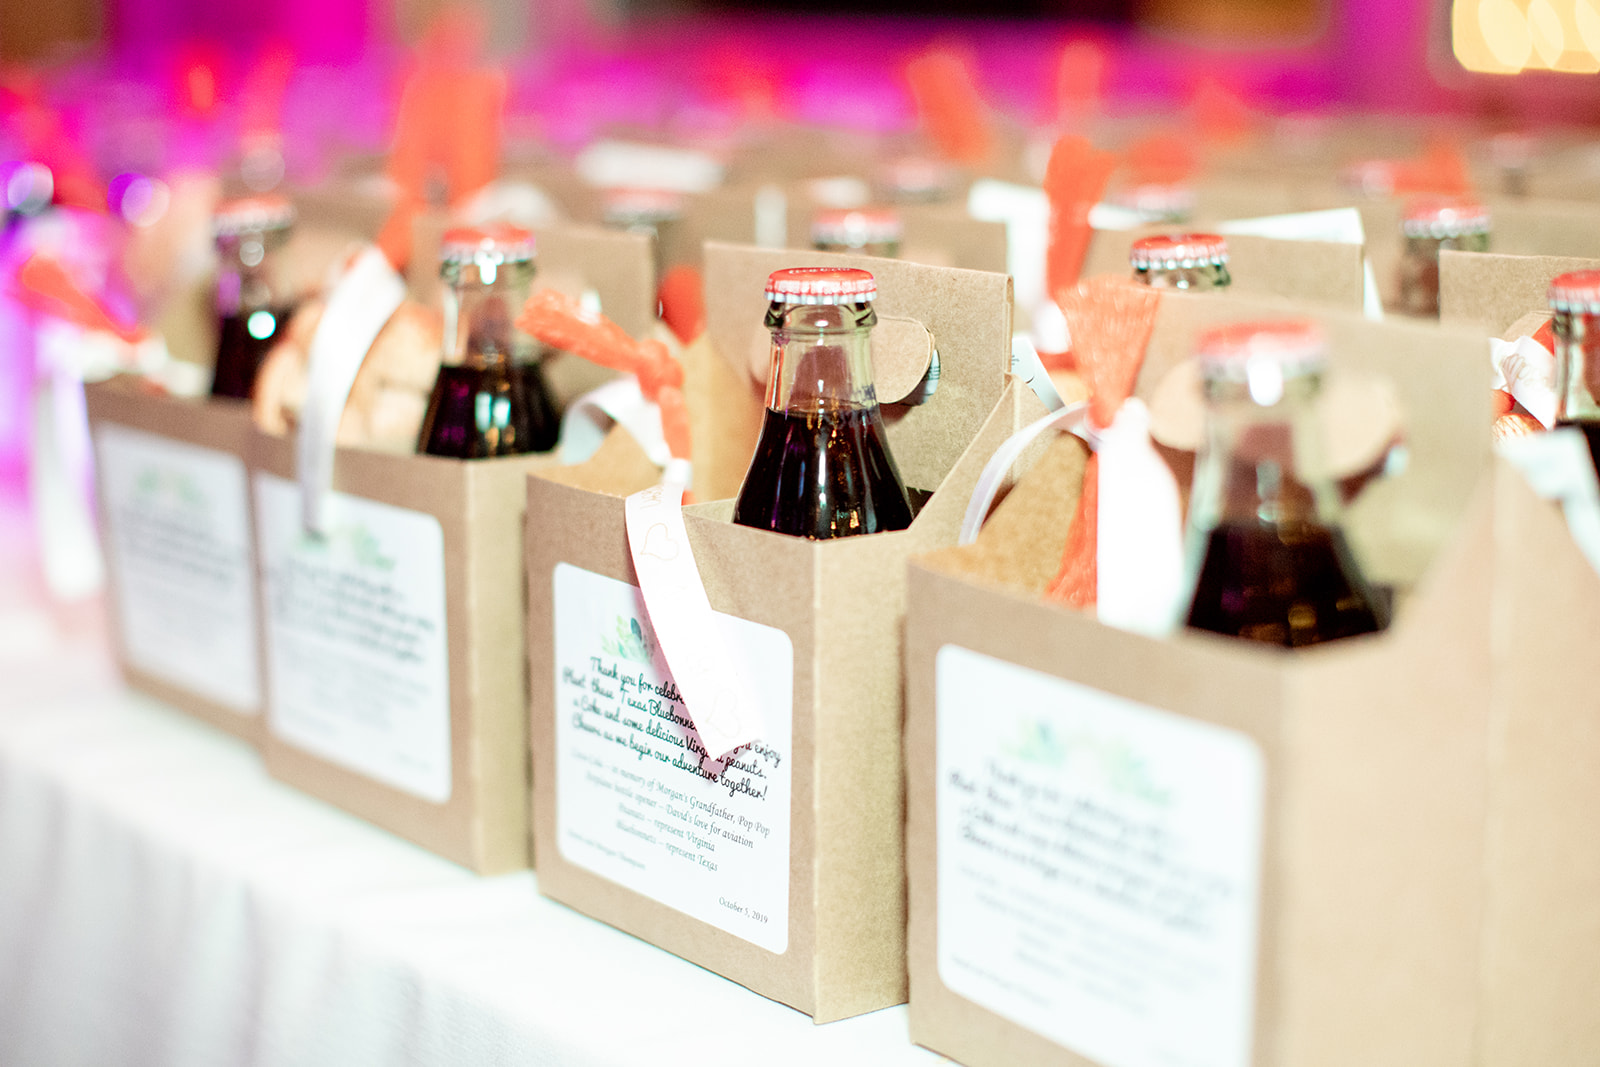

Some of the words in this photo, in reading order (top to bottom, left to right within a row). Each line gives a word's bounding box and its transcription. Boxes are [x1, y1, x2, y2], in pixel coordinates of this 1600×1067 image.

[590, 656, 619, 680] Thank
[620, 673, 637, 692] you
[638, 672, 654, 694] for
[655, 681, 685, 705] celebr
[581, 695, 603, 716] Coke
[604, 706, 620, 723] and
[622, 717, 644, 732] some
[645, 718, 685, 748] delicious
[723, 757, 767, 779] peanuts.
[620, 687, 647, 713] Texas
[648, 699, 697, 732] Bluebonne
[754, 743, 781, 769] enjoy
[629, 733, 653, 761] begin
[655, 751, 671, 764] our
[672, 753, 719, 783] adventure
[719, 770, 768, 801] together!
[647, 778, 657, 792] of
[656, 781, 688, 801] Morgan's
[689, 796, 736, 824] Grandfather,
[737, 815, 754, 833] Pop
[754, 821, 771, 840] Pop
[665, 803, 693, 823] David's
[693, 814, 709, 830] love
[707, 822, 721, 836] for
[722, 830, 754, 849] aviation
[654, 819, 684, 840] represent
[686, 830, 715, 852] Virginia
[666, 842, 696, 863] represent
[698, 854, 718, 872] Texas
[719, 896, 743, 914] October
[745, 907, 751, 919] 5,
[752, 910, 769, 925] 2019
